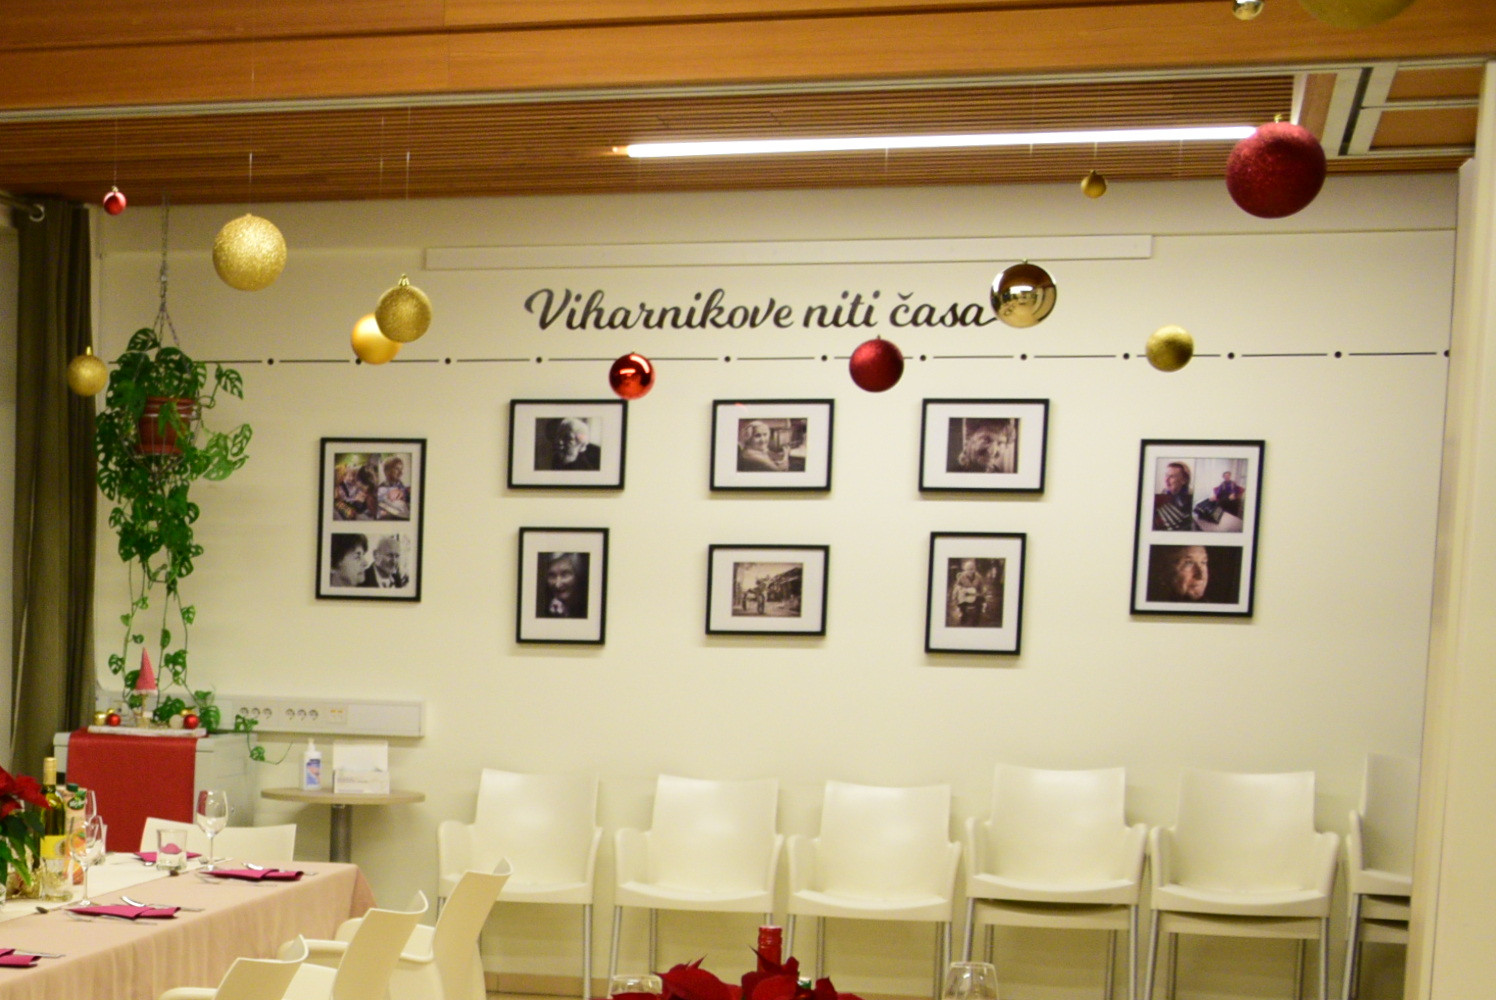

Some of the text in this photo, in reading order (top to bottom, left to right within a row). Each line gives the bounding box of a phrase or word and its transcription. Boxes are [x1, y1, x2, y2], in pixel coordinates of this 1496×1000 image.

[524, 288, 996, 330] Viharnikove niti časa
